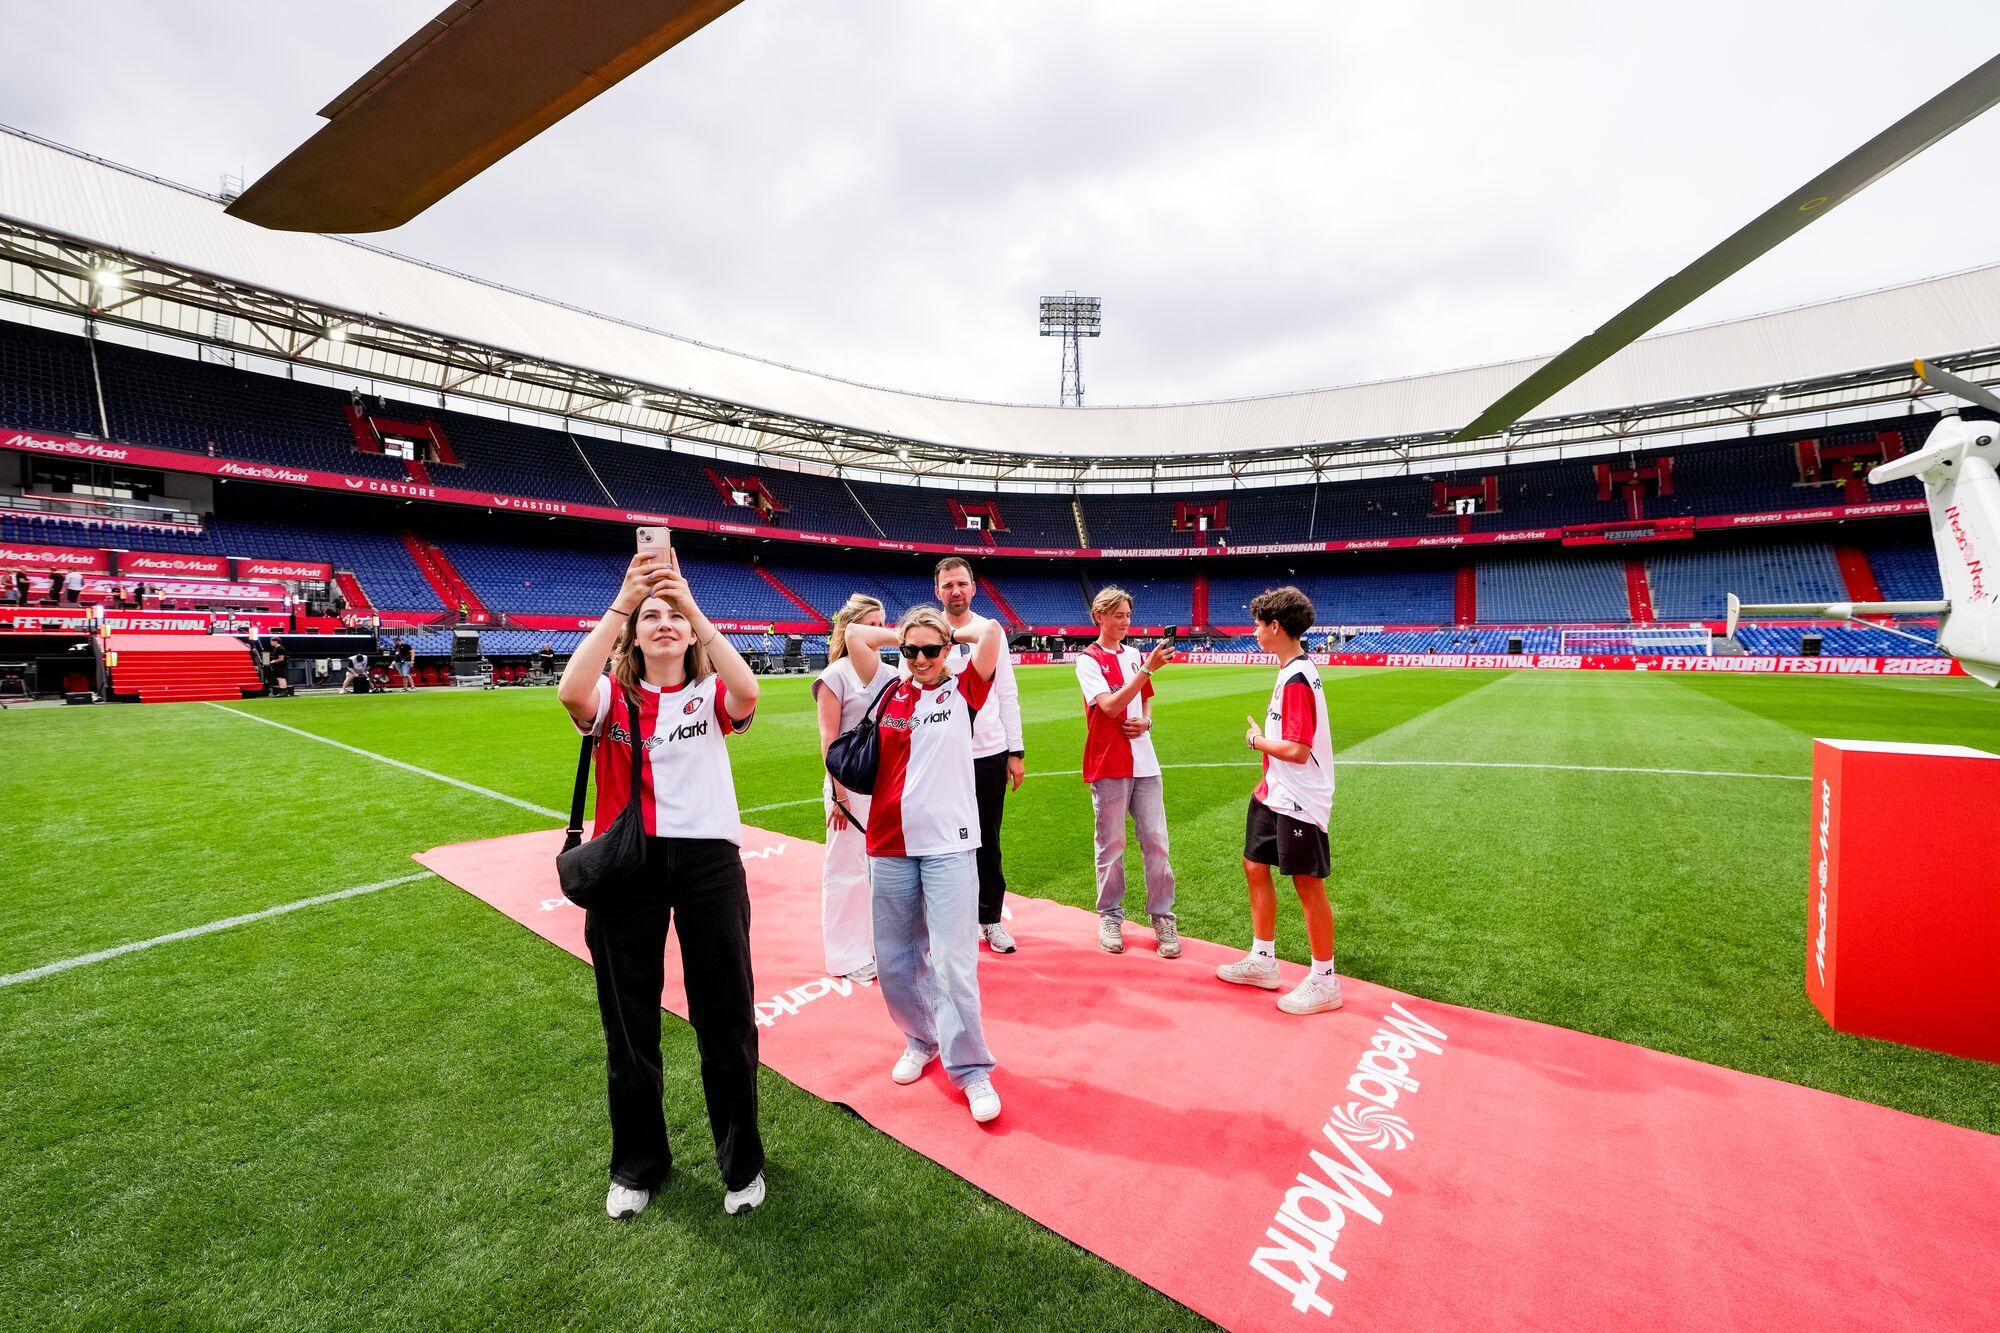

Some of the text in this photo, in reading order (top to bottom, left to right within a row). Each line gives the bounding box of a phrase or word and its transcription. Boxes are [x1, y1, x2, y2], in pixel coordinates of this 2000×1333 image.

[6, 434, 128, 460] Media Markt
[218, 463, 309, 483] Media Markt
[369, 481, 436, 498] CASTORE
[513, 499, 567, 513] CASTORE
[53, 553, 95, 564] Markt
[1100, 549, 1138, 557] WINNAAR
[131, 557, 218, 572] Media Markt
[248, 564, 321, 577] Media Markt
[129, 618, 207, 630] FESTIVAL
[1187, 653, 1248, 664] FEYENOORD
[1386, 655, 1582, 669] FEYENOORD FESTIVAL 2026
[1661, 656, 1952, 675] FEYENOORD FESTIVAL 2026
[923, 709, 951, 725] Markt
[668, 719, 708, 742] Markt
[1248, 1001, 1448, 1318] Media Markt
